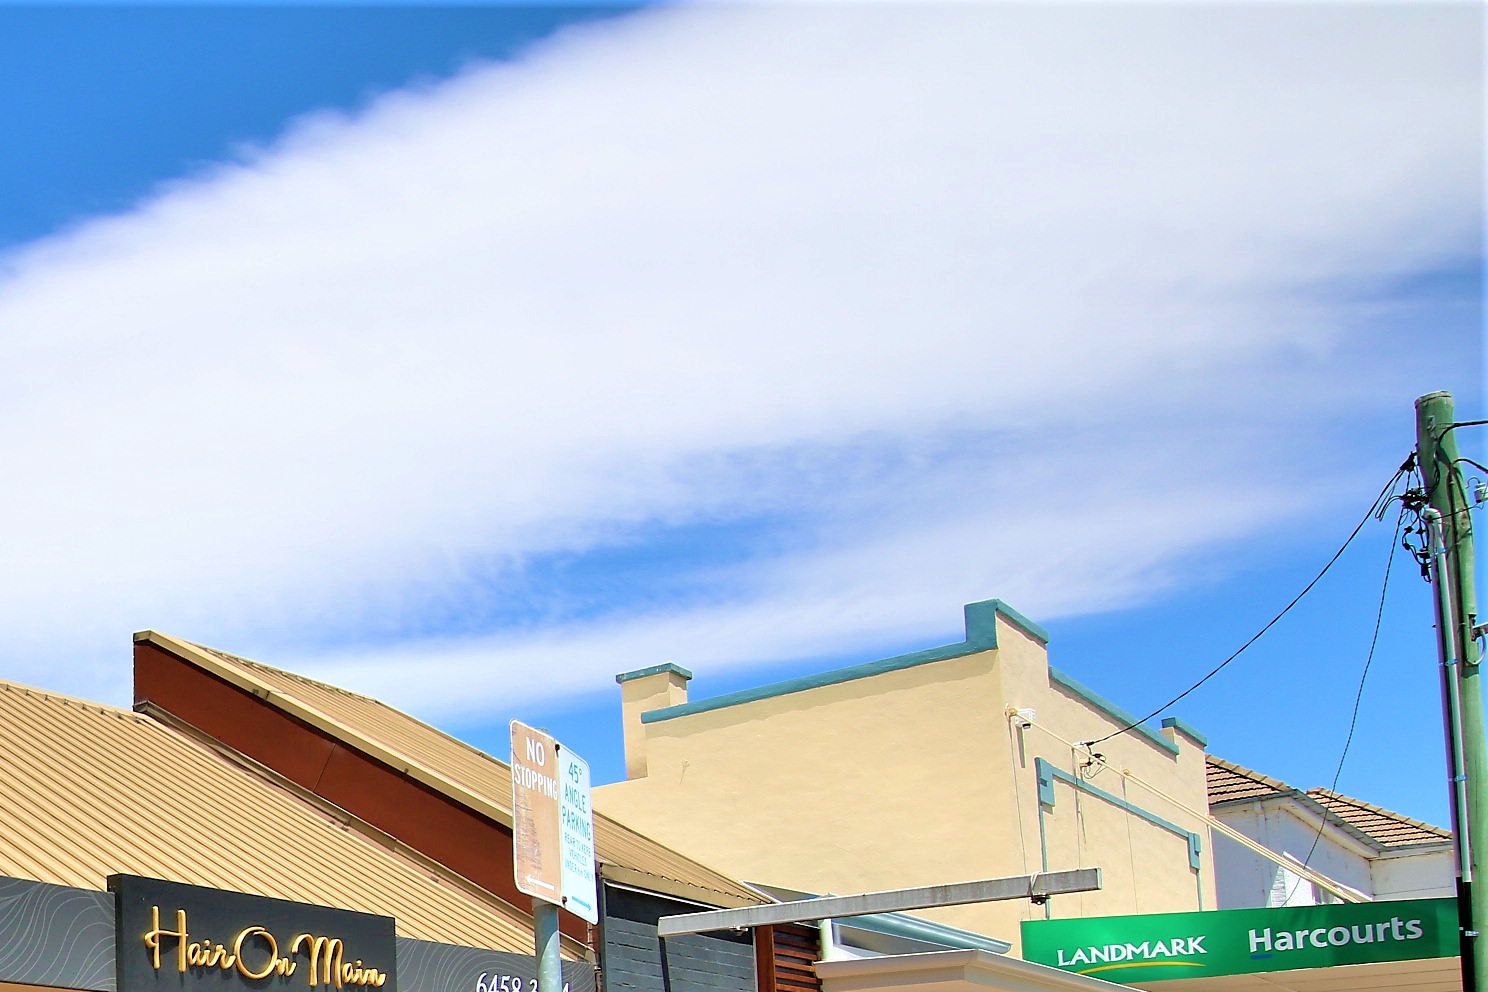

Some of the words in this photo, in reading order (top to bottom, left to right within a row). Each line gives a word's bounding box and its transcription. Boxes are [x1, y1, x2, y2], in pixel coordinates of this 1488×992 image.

[526, 736, 545, 767] NO
[514, 763, 558, 801] STOPPING
[564, 782, 587, 814] ANGLE
[561, 805, 591, 842] PARKING
[144, 904, 237, 974] Hair
[233, 925, 297, 981] On
[291, 933, 387, 990] Main
[1056, 935, 1208, 967] LANDMARK
[1248, 915, 1424, 953] Harcourts
